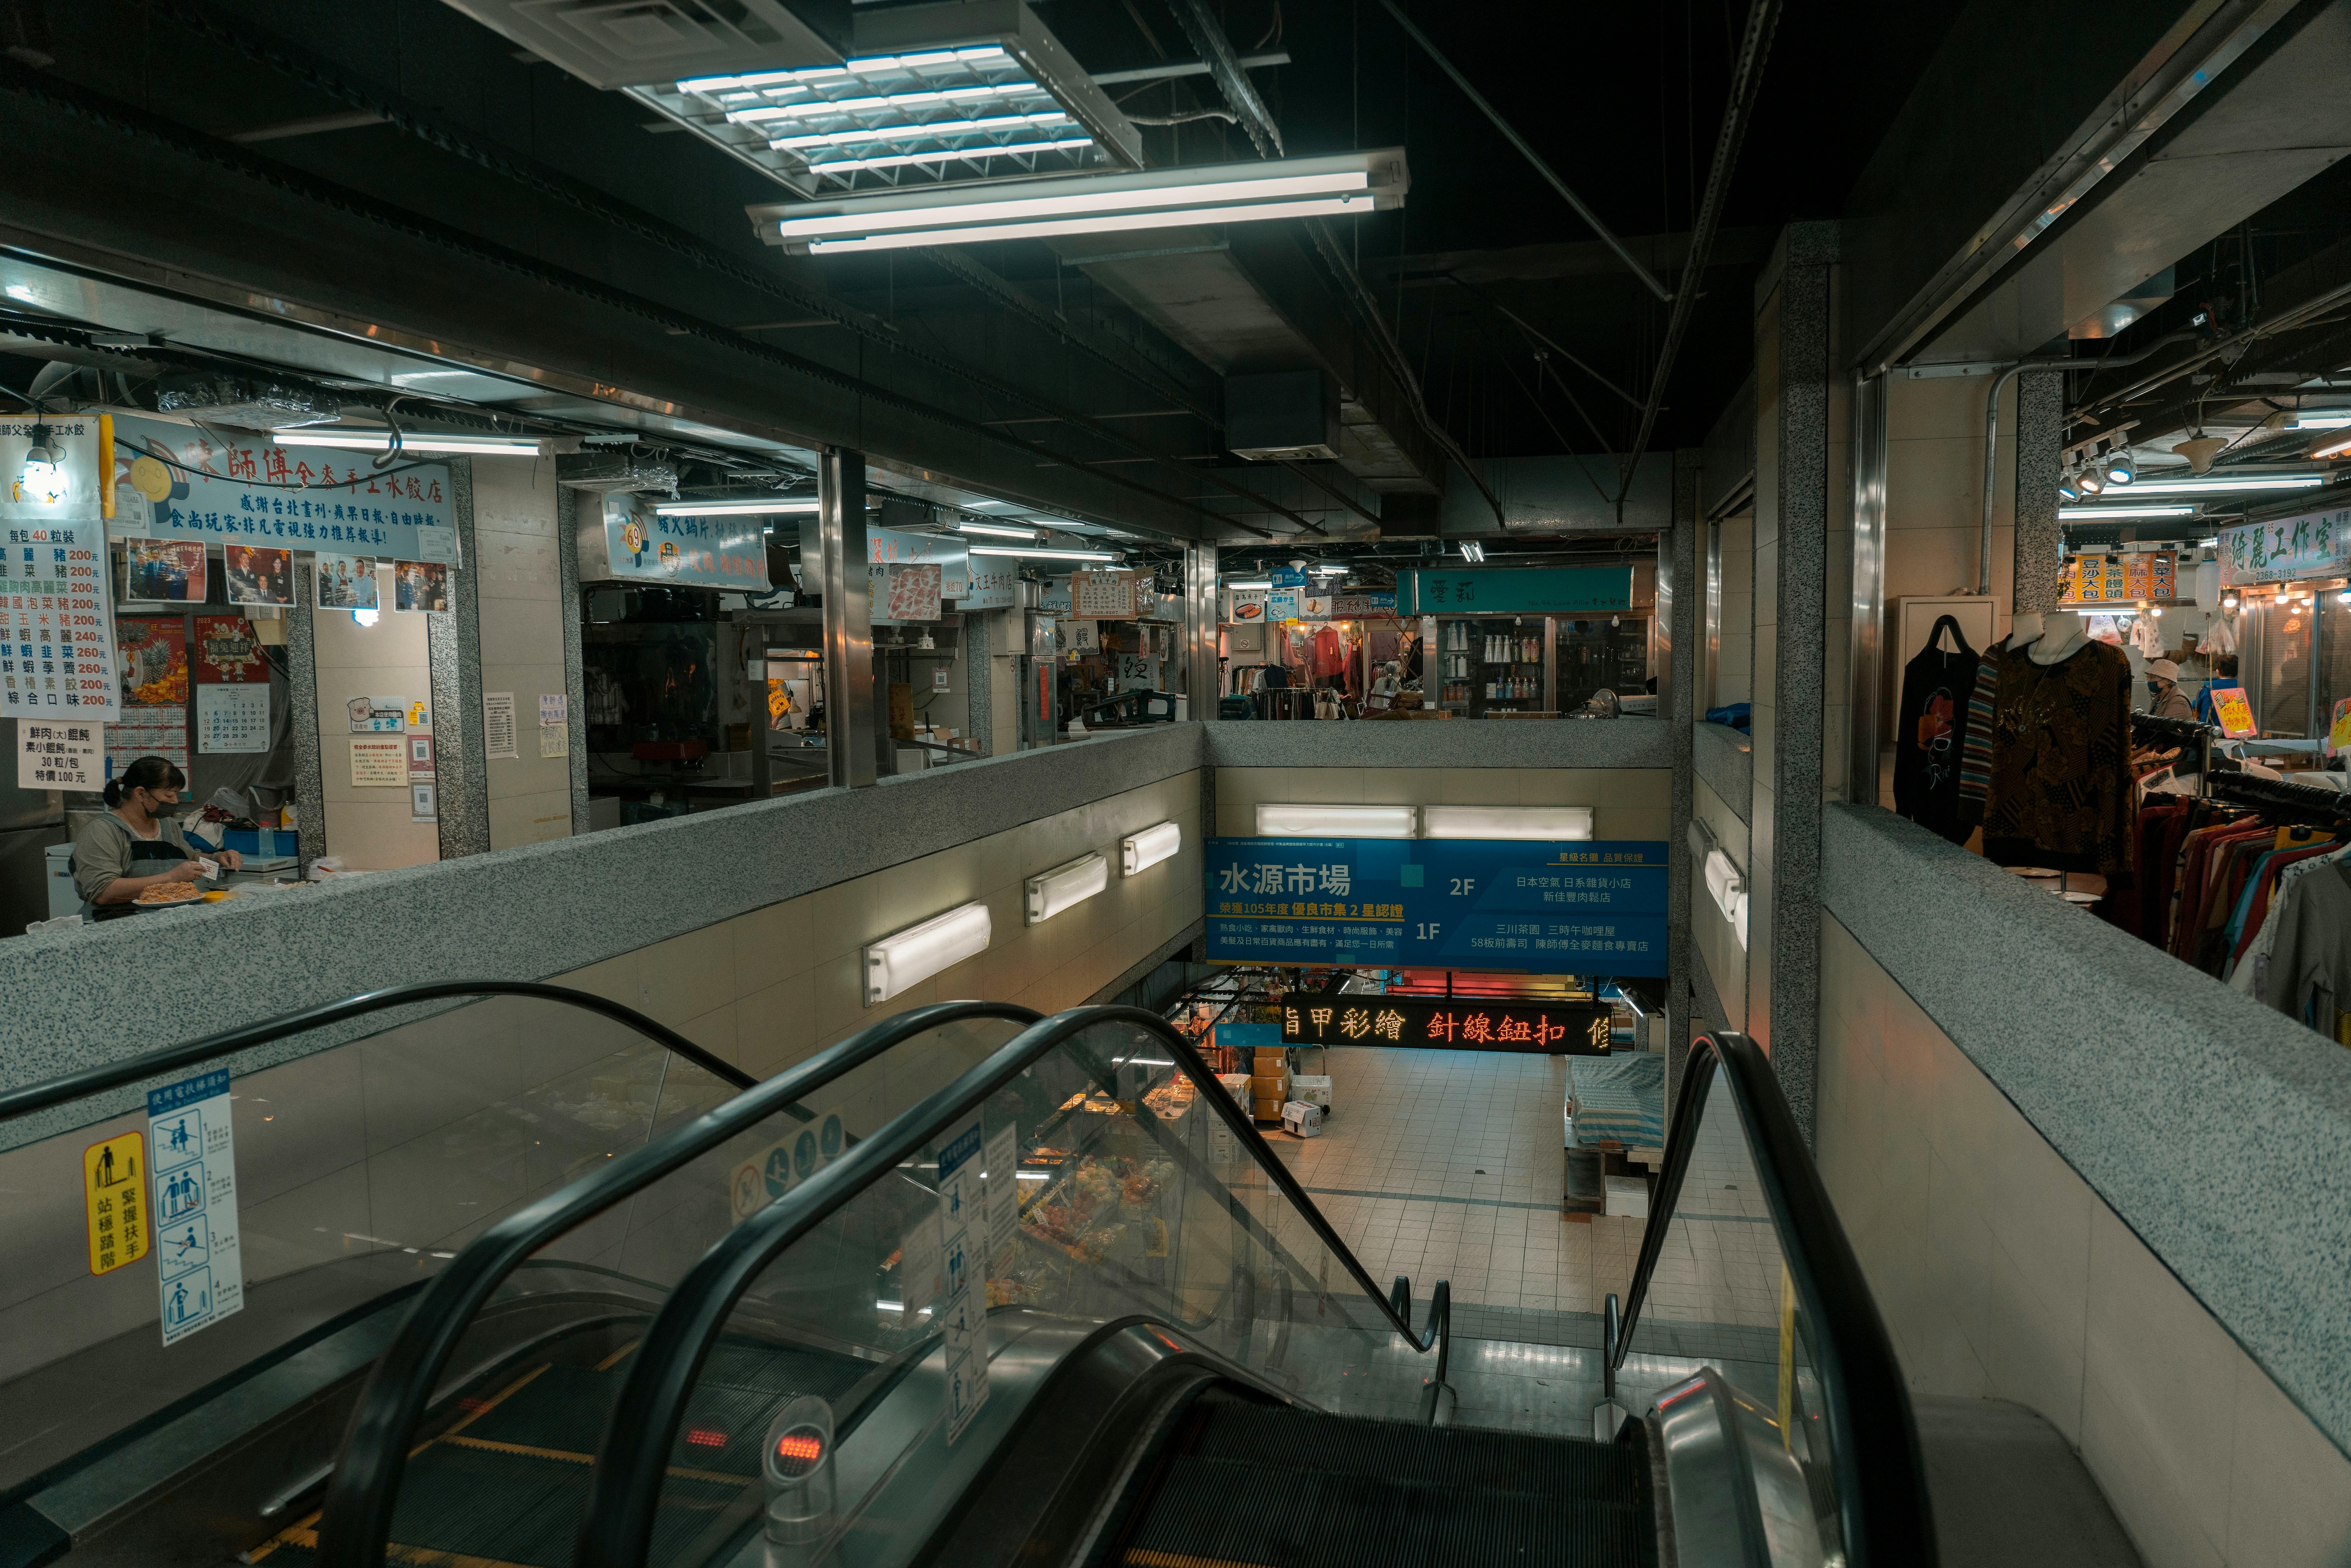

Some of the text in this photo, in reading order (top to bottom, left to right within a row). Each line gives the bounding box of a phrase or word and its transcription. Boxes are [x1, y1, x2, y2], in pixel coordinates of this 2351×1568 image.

[2267, 523, 2274, 534] 65
[33, 530, 47, 541] 40
[627, 528, 639, 547] 69
[2081, 559, 2100, 599] 豆沙大包
[2256, 568, 2296, 581] 2368-3192
[975, 572, 1012, 591] 文王牛肉店
[42, 757, 52, 767] 30
[58, 772, 73, 782] 100
[1603, 852, 1643, 864] 品質保證
[1220, 862, 1351, 897] 水源市場
[1450, 876, 1632, 896] 2F 日本空氣 日系雜貨小店
[1219, 902, 1289, 915] 榮獲105年度
[1292, 902, 1347, 917] 優良市集
[1362, 903, 1404, 919] 星認證
[1416, 922, 1616, 940] 1F 三川茶園 三時午咖哩屋
[1471, 938, 1528, 949] 58板前壽司
[207, 1171, 212, 1181] 2
[121, 1187, 141, 1259] 緊握扶手
[97, 1197, 116, 1270] 站穩踏階
[211, 1232, 216, 1242] 3
[214, 1280, 220, 1289] 4
